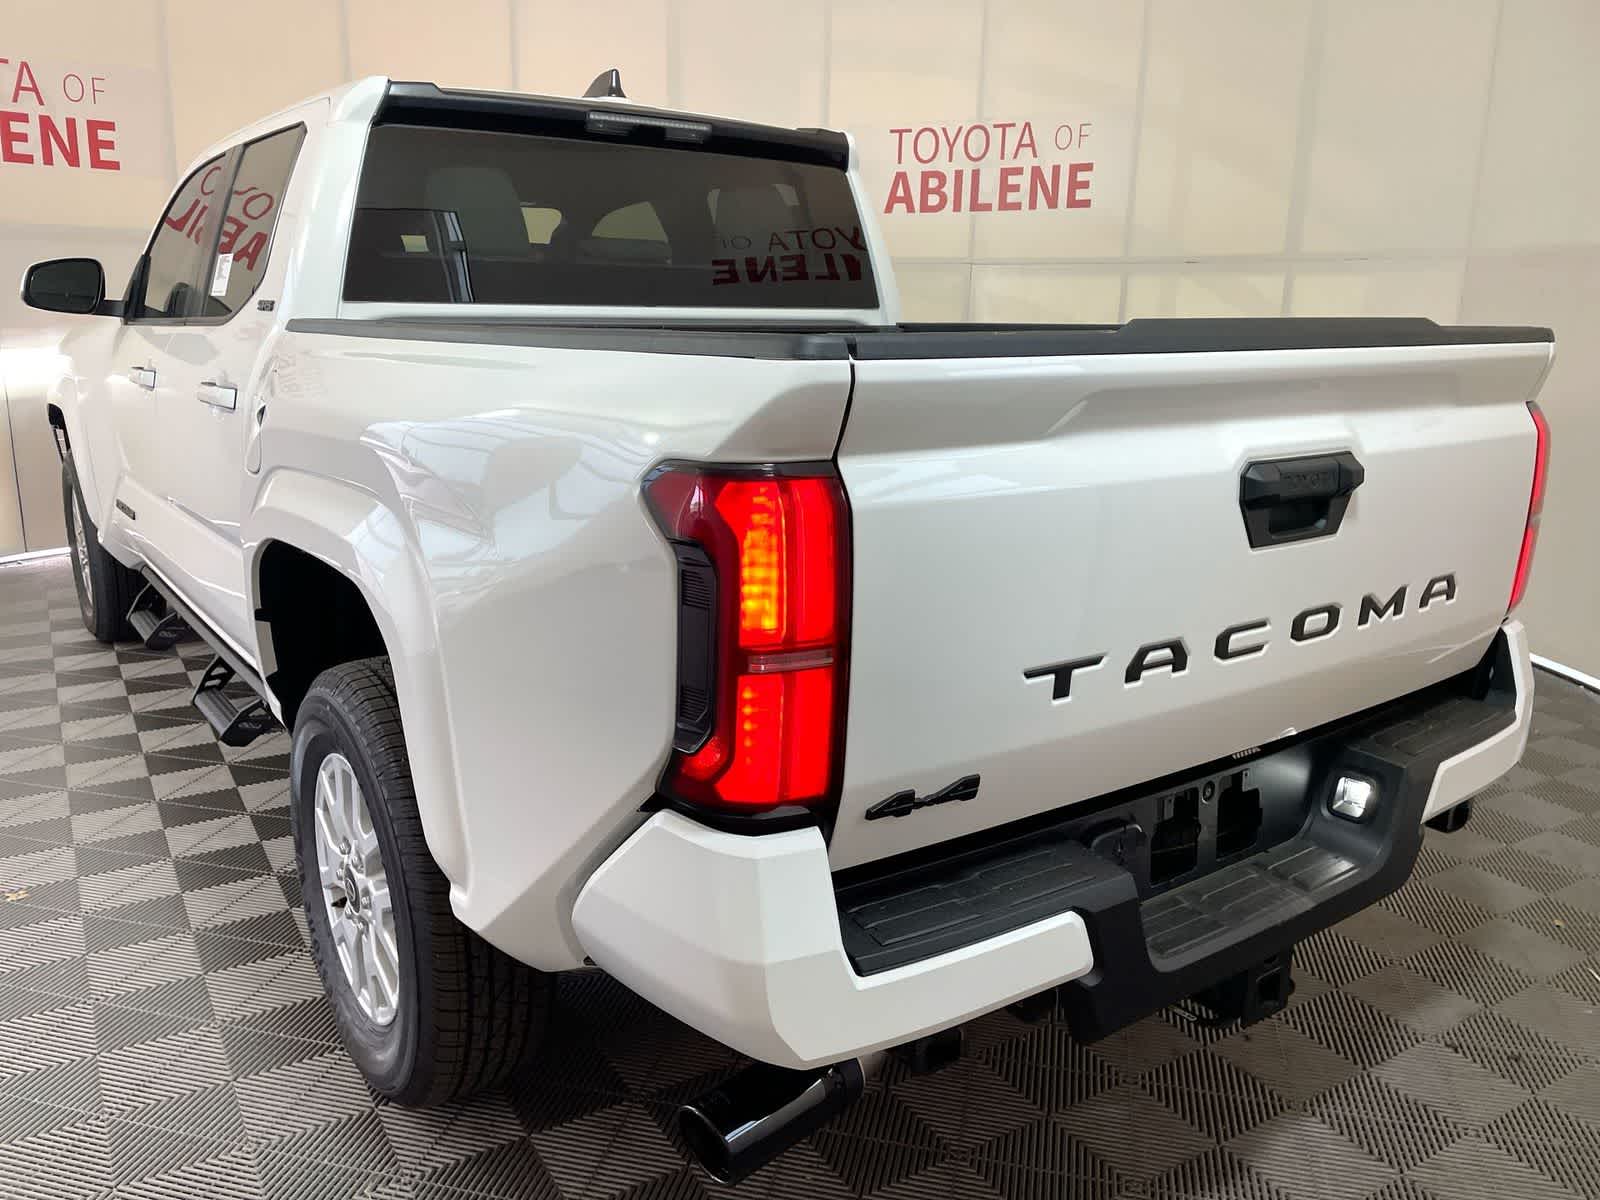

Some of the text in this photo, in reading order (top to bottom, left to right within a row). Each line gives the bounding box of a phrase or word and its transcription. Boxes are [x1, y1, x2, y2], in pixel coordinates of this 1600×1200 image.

[63, 73, 105, 105] OF
[889, 121, 1092, 164] TOYOTA OF
[884, 162, 1094, 213] ABILENE
[1023, 572, 1457, 702] TACOMA
